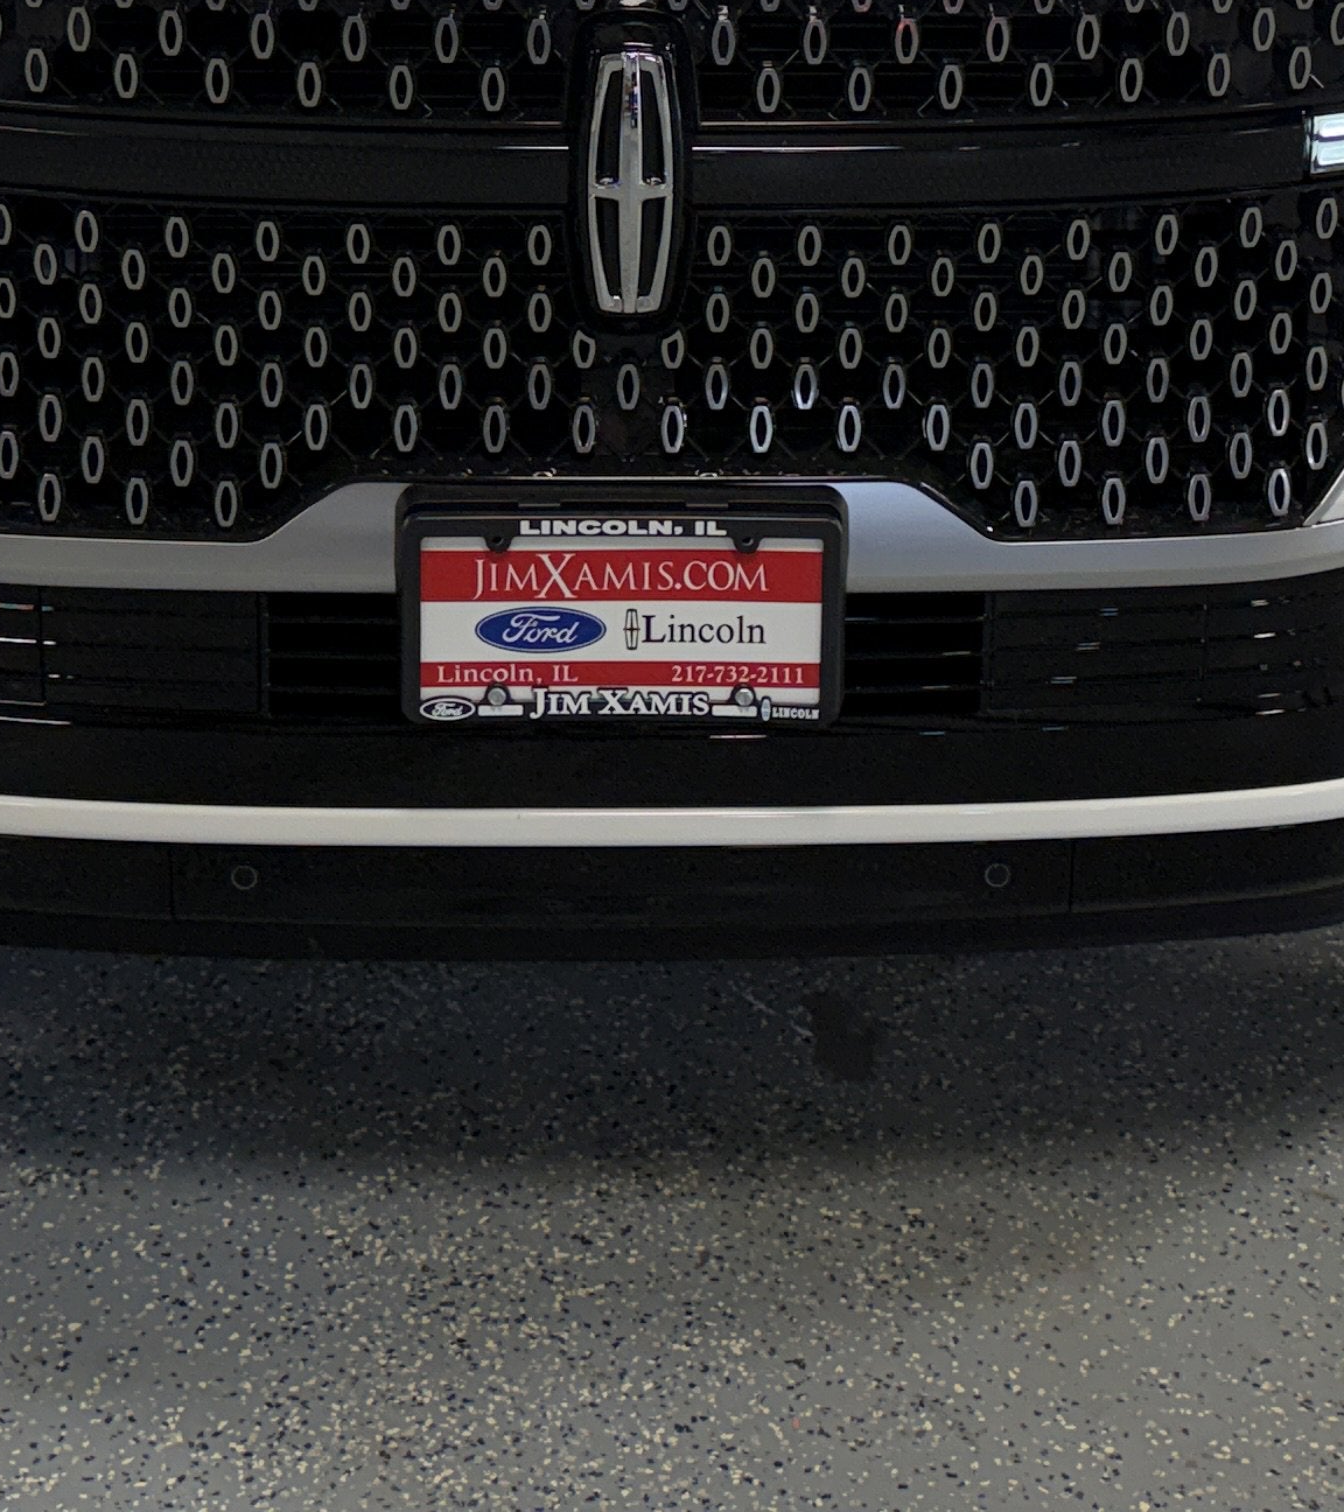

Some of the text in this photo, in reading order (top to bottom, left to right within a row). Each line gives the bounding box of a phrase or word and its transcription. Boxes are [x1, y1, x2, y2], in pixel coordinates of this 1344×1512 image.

[520, 520, 727, 536] LINCOLN, IL
[472, 553, 768, 600] JIMXAMIS.COM
[501, 613, 579, 645] Ford
[642, 615, 767, 644] Lincoln
[437, 664, 579, 684] Lincoln, IL
[671, 665, 803, 684] 217-732-2111
[431, 702, 463, 717] Ford
[530, 687, 710, 719] JIM XAMIS
[772, 707, 819, 720] LINCOLN
